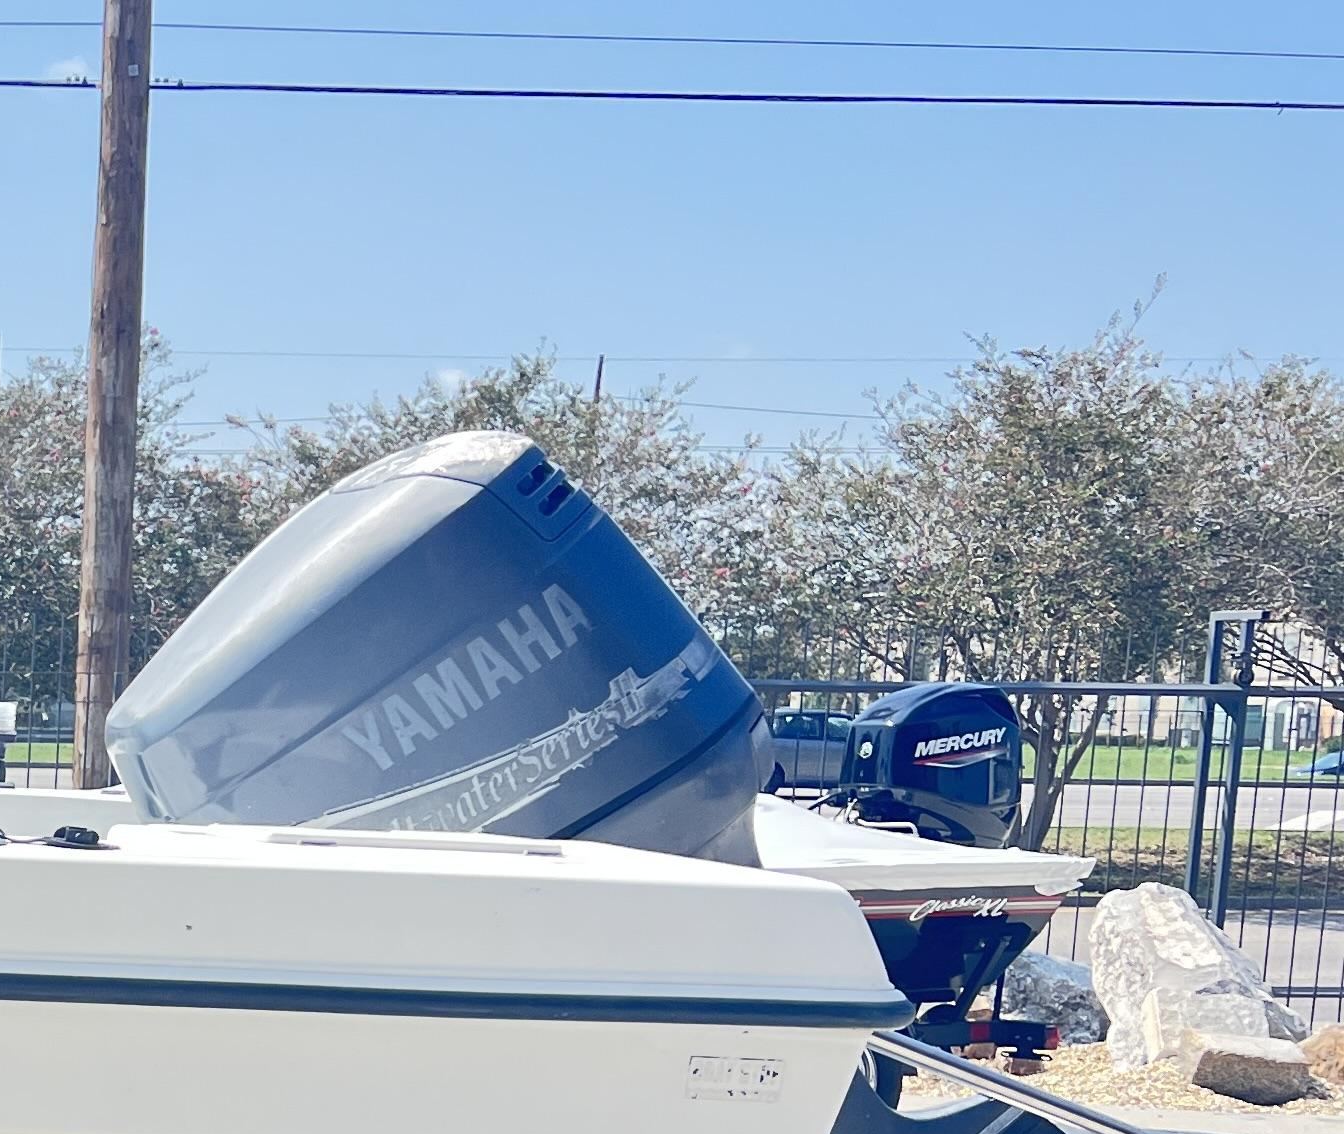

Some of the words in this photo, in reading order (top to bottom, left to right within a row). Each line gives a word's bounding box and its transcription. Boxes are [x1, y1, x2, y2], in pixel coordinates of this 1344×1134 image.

[342, 583, 593, 771] YAMAHA
[914, 726, 1007, 758] MERCURY
[909, 895, 984, 921] Classic
[973, 898, 1008, 917] XL
